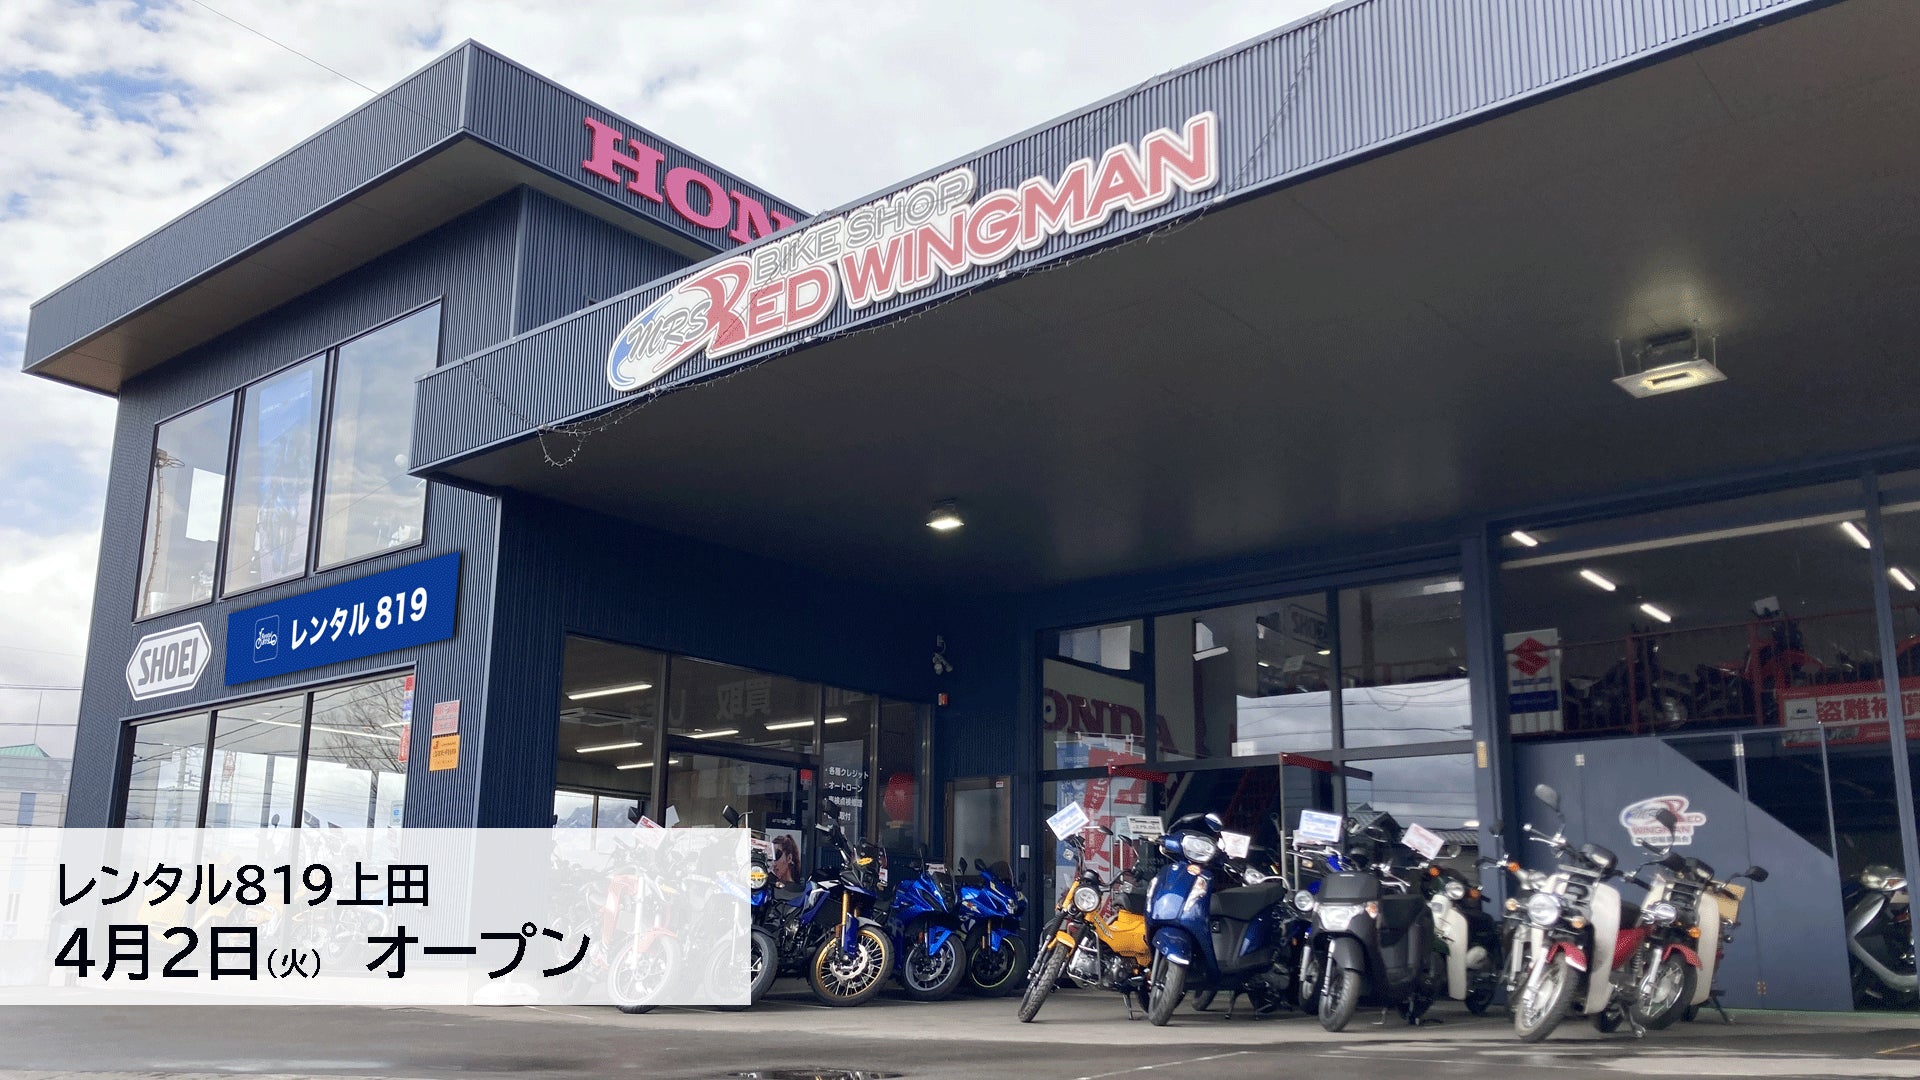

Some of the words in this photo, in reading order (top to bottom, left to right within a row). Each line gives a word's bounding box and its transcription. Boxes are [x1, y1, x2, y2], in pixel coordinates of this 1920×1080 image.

[668, 260, 833, 356] RED
[843, 117, 1211, 303] WINGMAN
[754, 222, 841, 286] BIKE
[846, 171, 969, 249] SHOP
[626, 300, 711, 361] MRS
[138, 637, 199, 687] SHOEI
